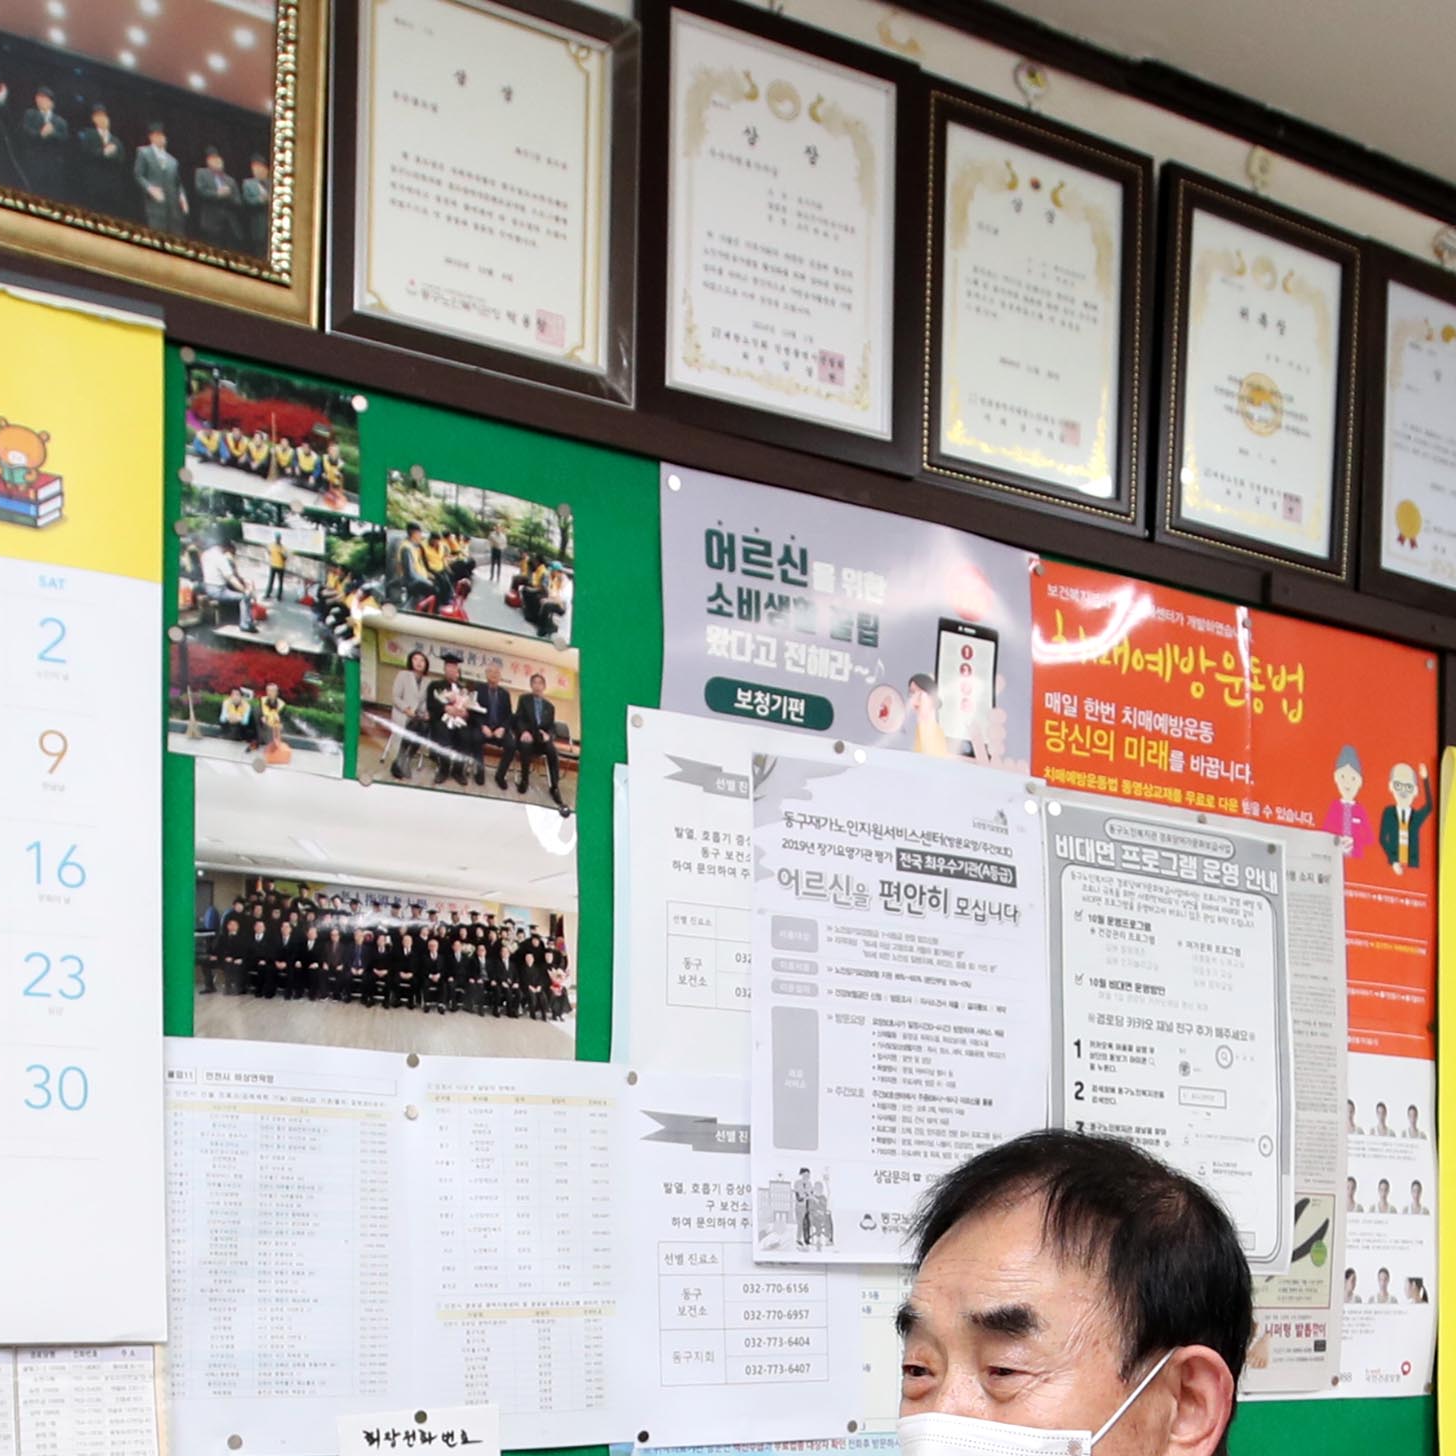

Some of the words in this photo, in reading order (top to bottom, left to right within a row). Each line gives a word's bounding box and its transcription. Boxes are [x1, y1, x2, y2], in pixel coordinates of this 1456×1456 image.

[38, 575, 65, 590] SAT
[37, 618, 67, 664] 2
[733, 688, 806, 723] 보청기편
[1044, 692, 1079, 719] 매일
[1084, 697, 1117, 725] 한번
[1121, 703, 1214, 744] 치매예방운동
[38, 730, 68, 775] 9
[1044, 720, 1115, 761] 당신의
[1124, 732, 1185, 773] 미래를
[1190, 754, 1255, 785] 바꿉니다.
[1185, 789, 1216, 809] 무료로
[1218, 794, 1239, 813] 다운
[1263, 806, 1273, 818] 수
[1275, 809, 1317, 827] 있습니다.
[25, 841, 86, 888] 16
[781, 838, 816, 855] 2019년
[816, 841, 873, 862] 장기요양기관
[899, 852, 924, 869] 전국
[1055, 834, 1116, 867] 비대면
[1120, 844, 1198, 881] 프로그램
[1202, 854, 1240, 886] 운영
[1245, 868, 1279, 896] 안내
[776, 867, 871, 909] 어르신을
[879, 879, 949, 916] 편안히
[954, 895, 1020, 924] 모십니다
[22, 952, 86, 1000] 23
[1125, 1016, 1154, 1031] 카카오
[1073, 1038, 1082, 1059] 1
[24, 1064, 89, 1111] 30
[1074, 1081, 1085, 1101] 2
[873, 1168, 910, 1185] 상담문의
